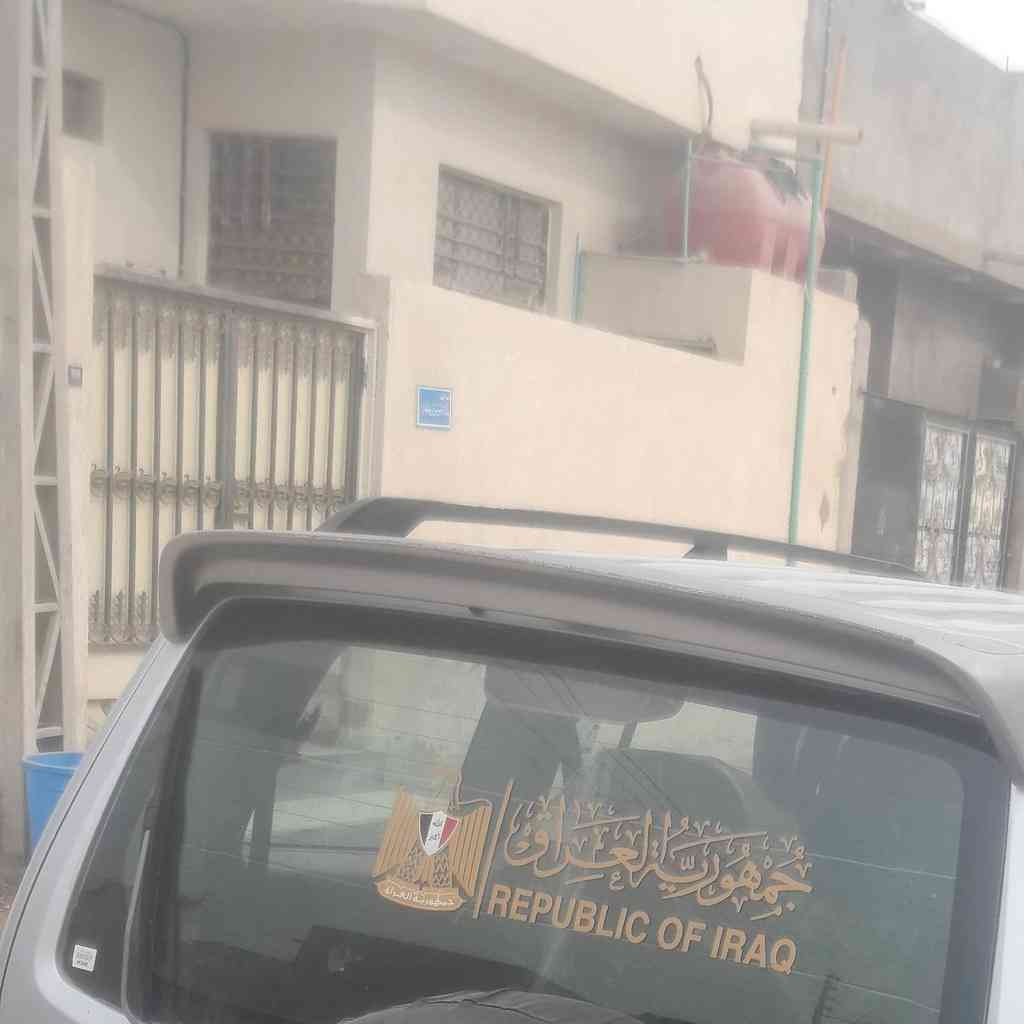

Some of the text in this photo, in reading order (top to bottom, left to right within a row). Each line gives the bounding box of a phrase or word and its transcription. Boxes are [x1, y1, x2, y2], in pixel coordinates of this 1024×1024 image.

[487, 884, 650, 945] REPUBLIC
[655, 916, 706, 953] OF
[708, 926, 798, 975] IRAQ
